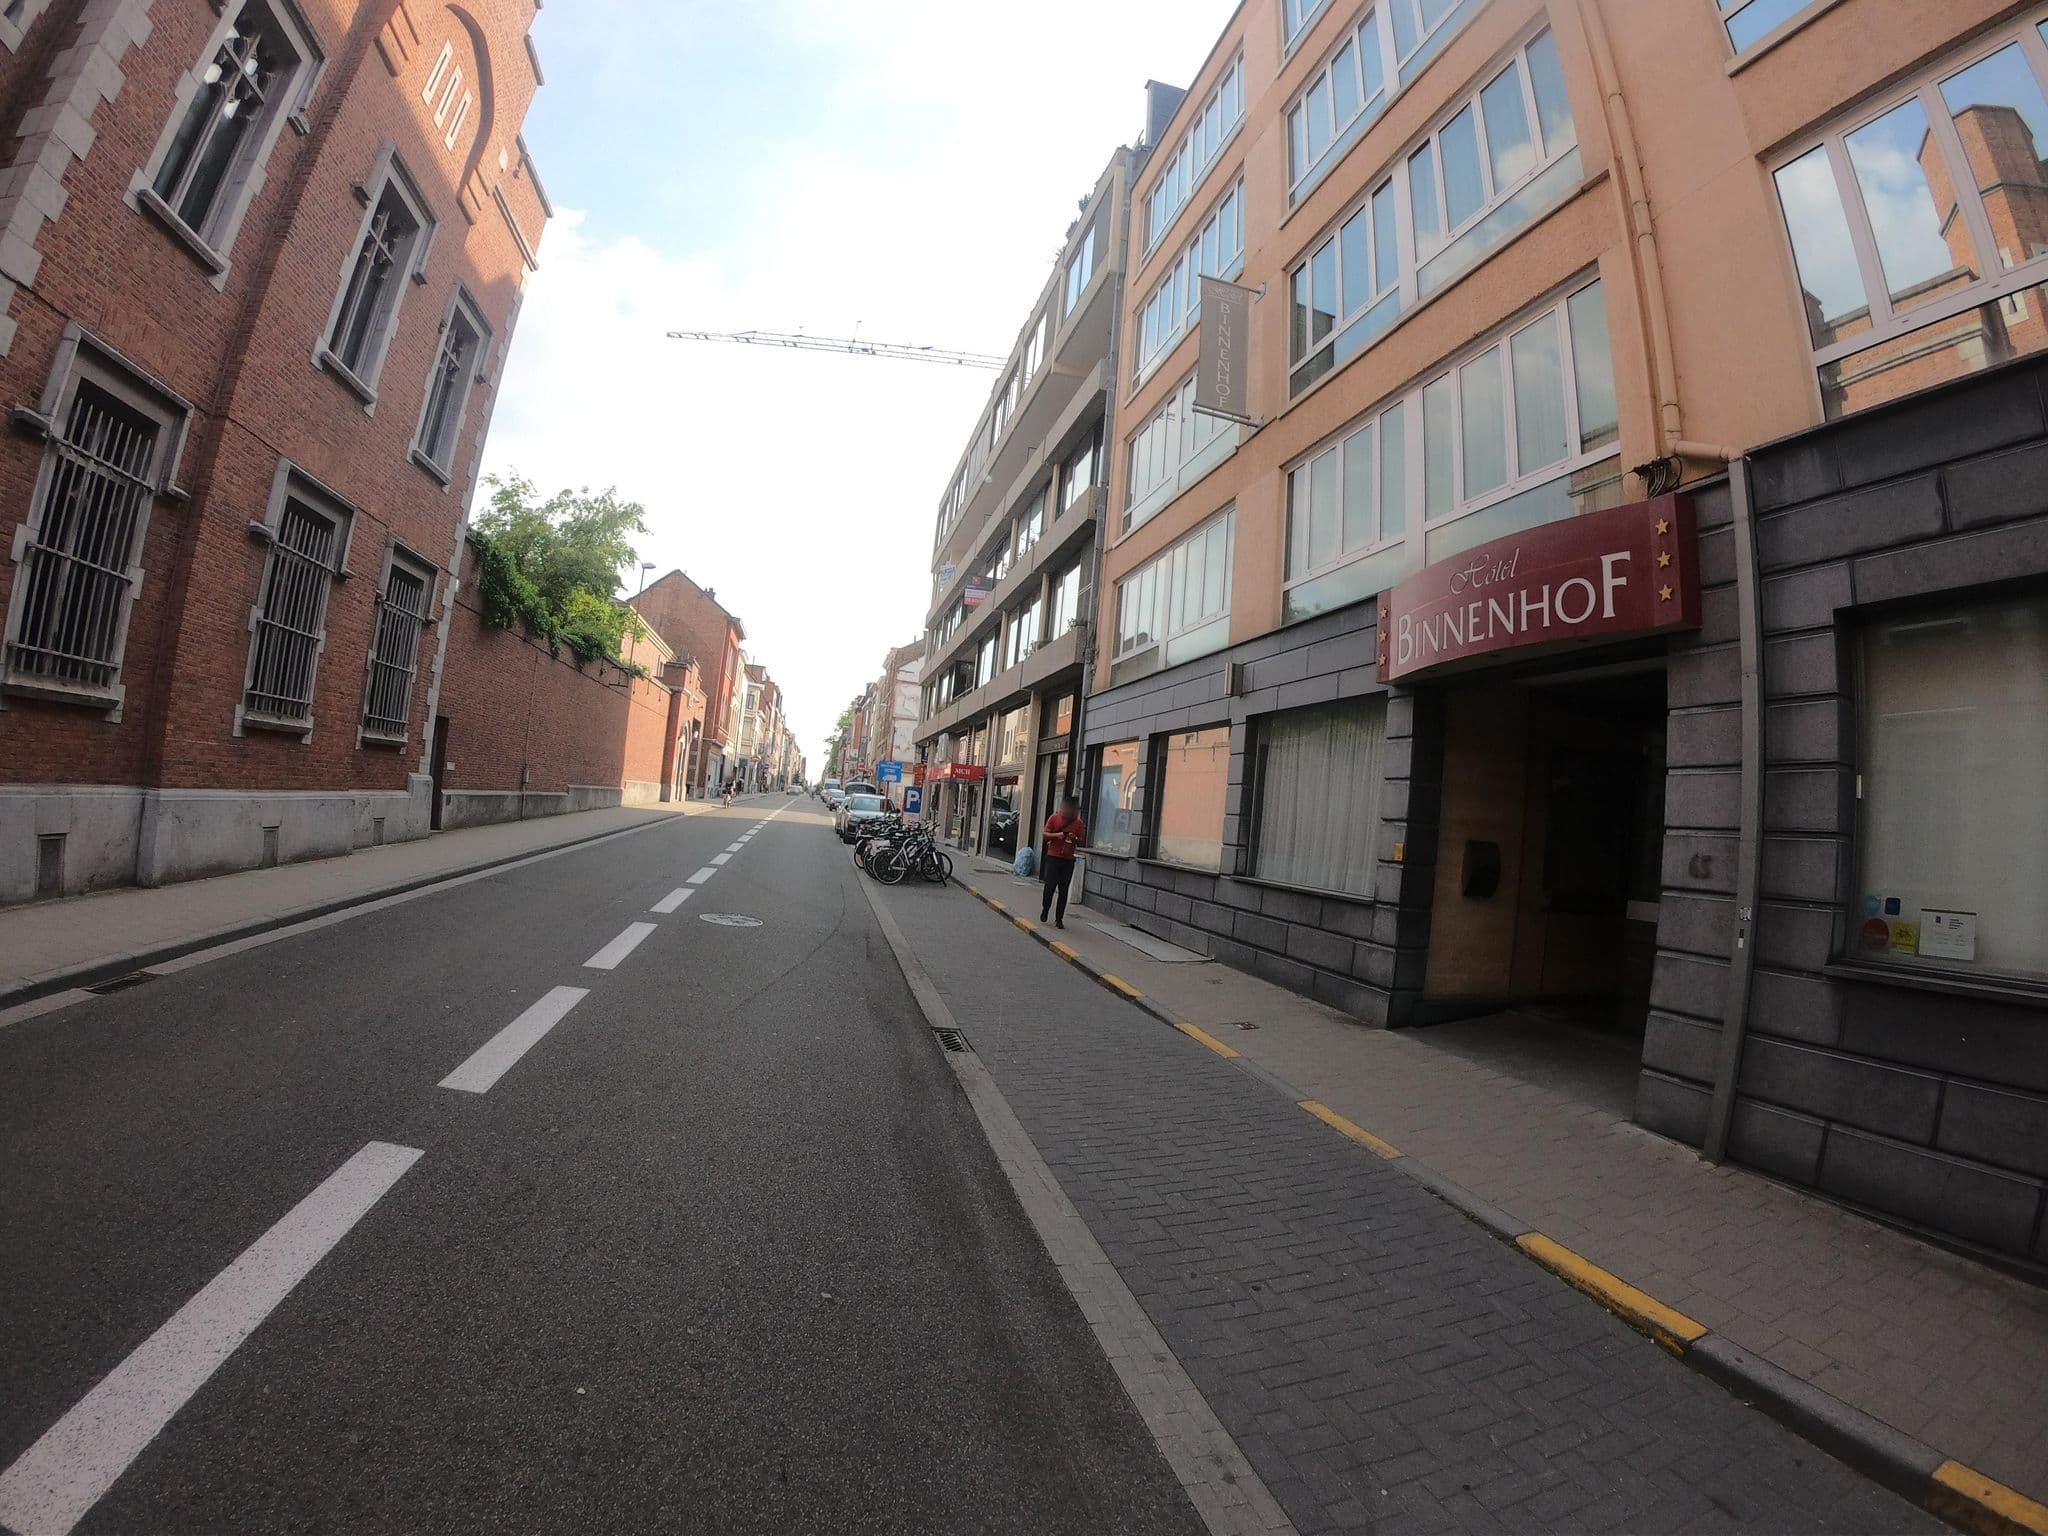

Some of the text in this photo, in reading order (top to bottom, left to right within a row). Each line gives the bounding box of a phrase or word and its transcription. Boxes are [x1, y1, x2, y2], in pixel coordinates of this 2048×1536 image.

[1216, 302, 1231, 408] BINNENHOF
[1397, 551, 1631, 664] BINNENHOF
[906, 790, 920, 809] P
